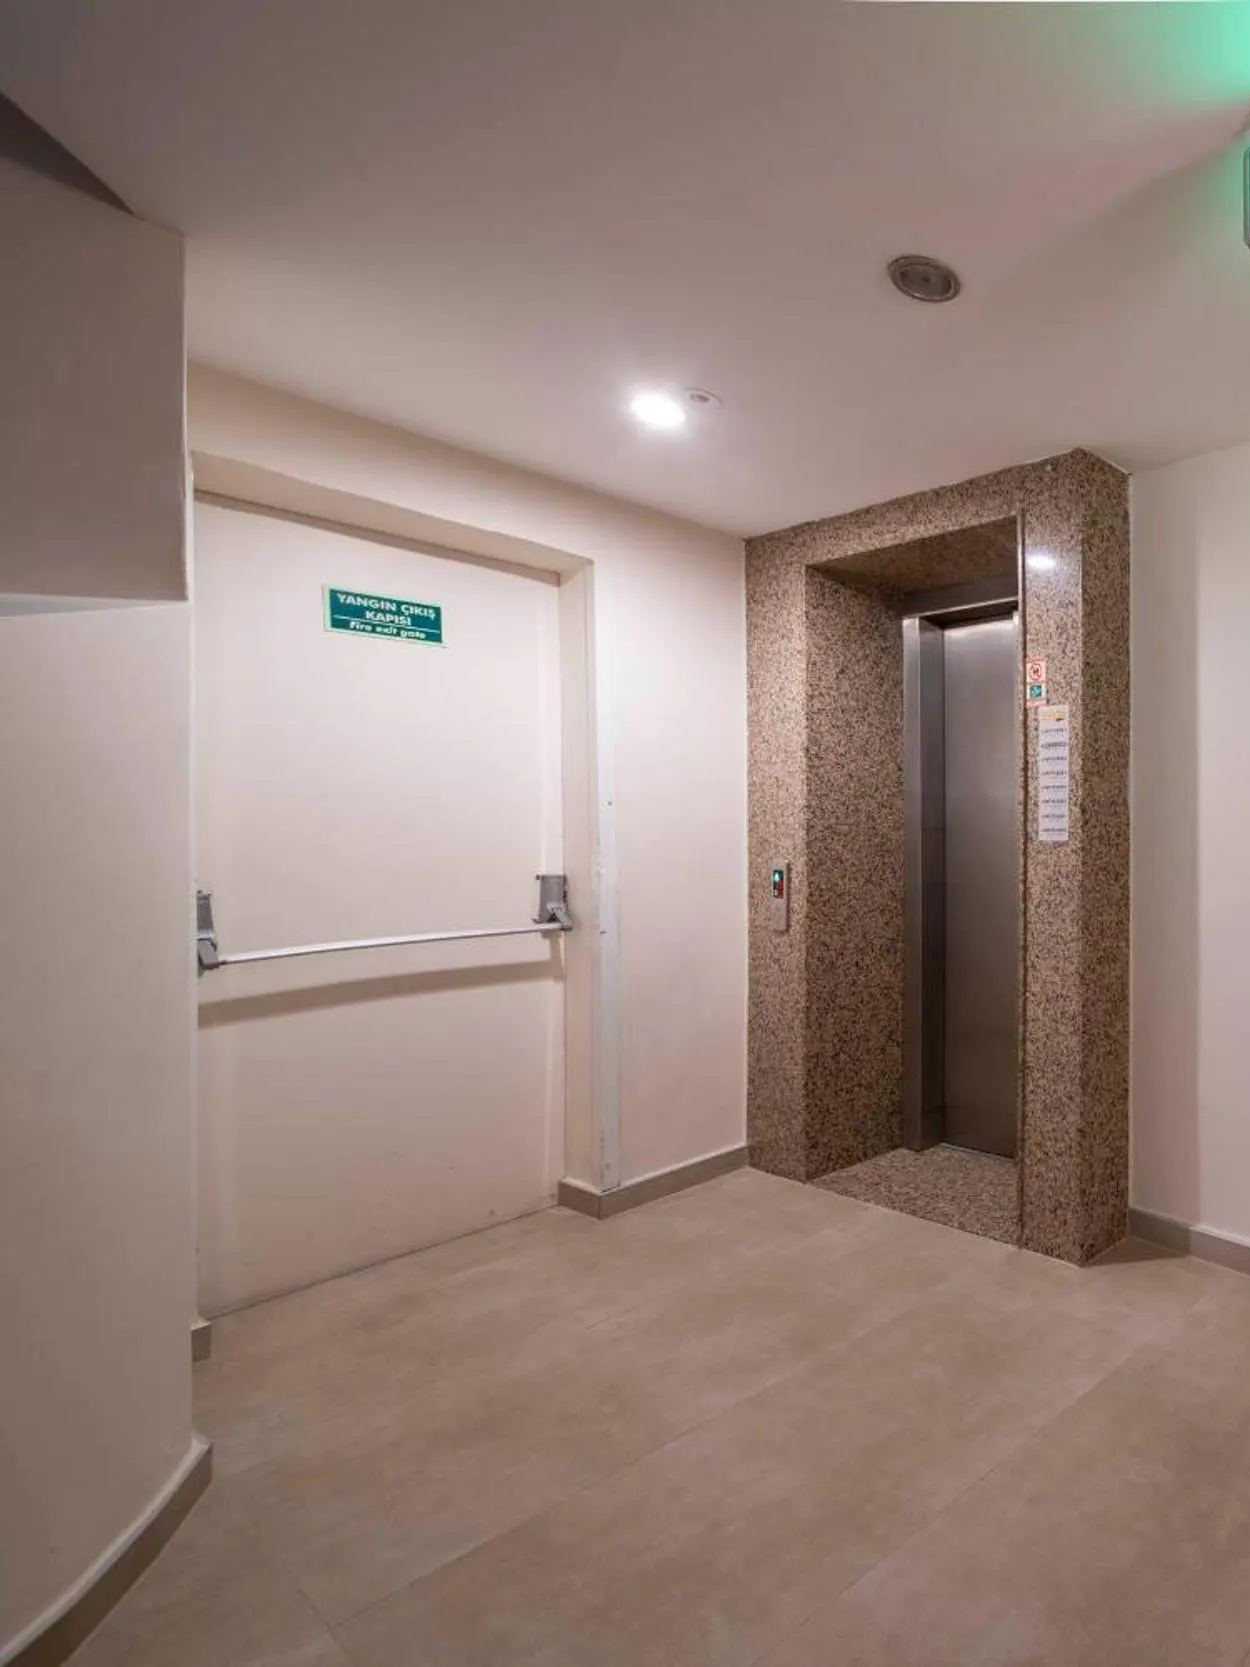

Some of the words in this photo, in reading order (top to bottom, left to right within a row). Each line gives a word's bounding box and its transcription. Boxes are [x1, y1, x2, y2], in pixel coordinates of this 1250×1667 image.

[336, 592, 397, 611] YANGIN
[400, 604, 436, 620] ÇIKIŞ
[364, 610, 412, 626] KAPISI
[349, 621, 373, 632] Fire
[375, 626, 398, 635] exit
[400, 629, 427, 639] gate
